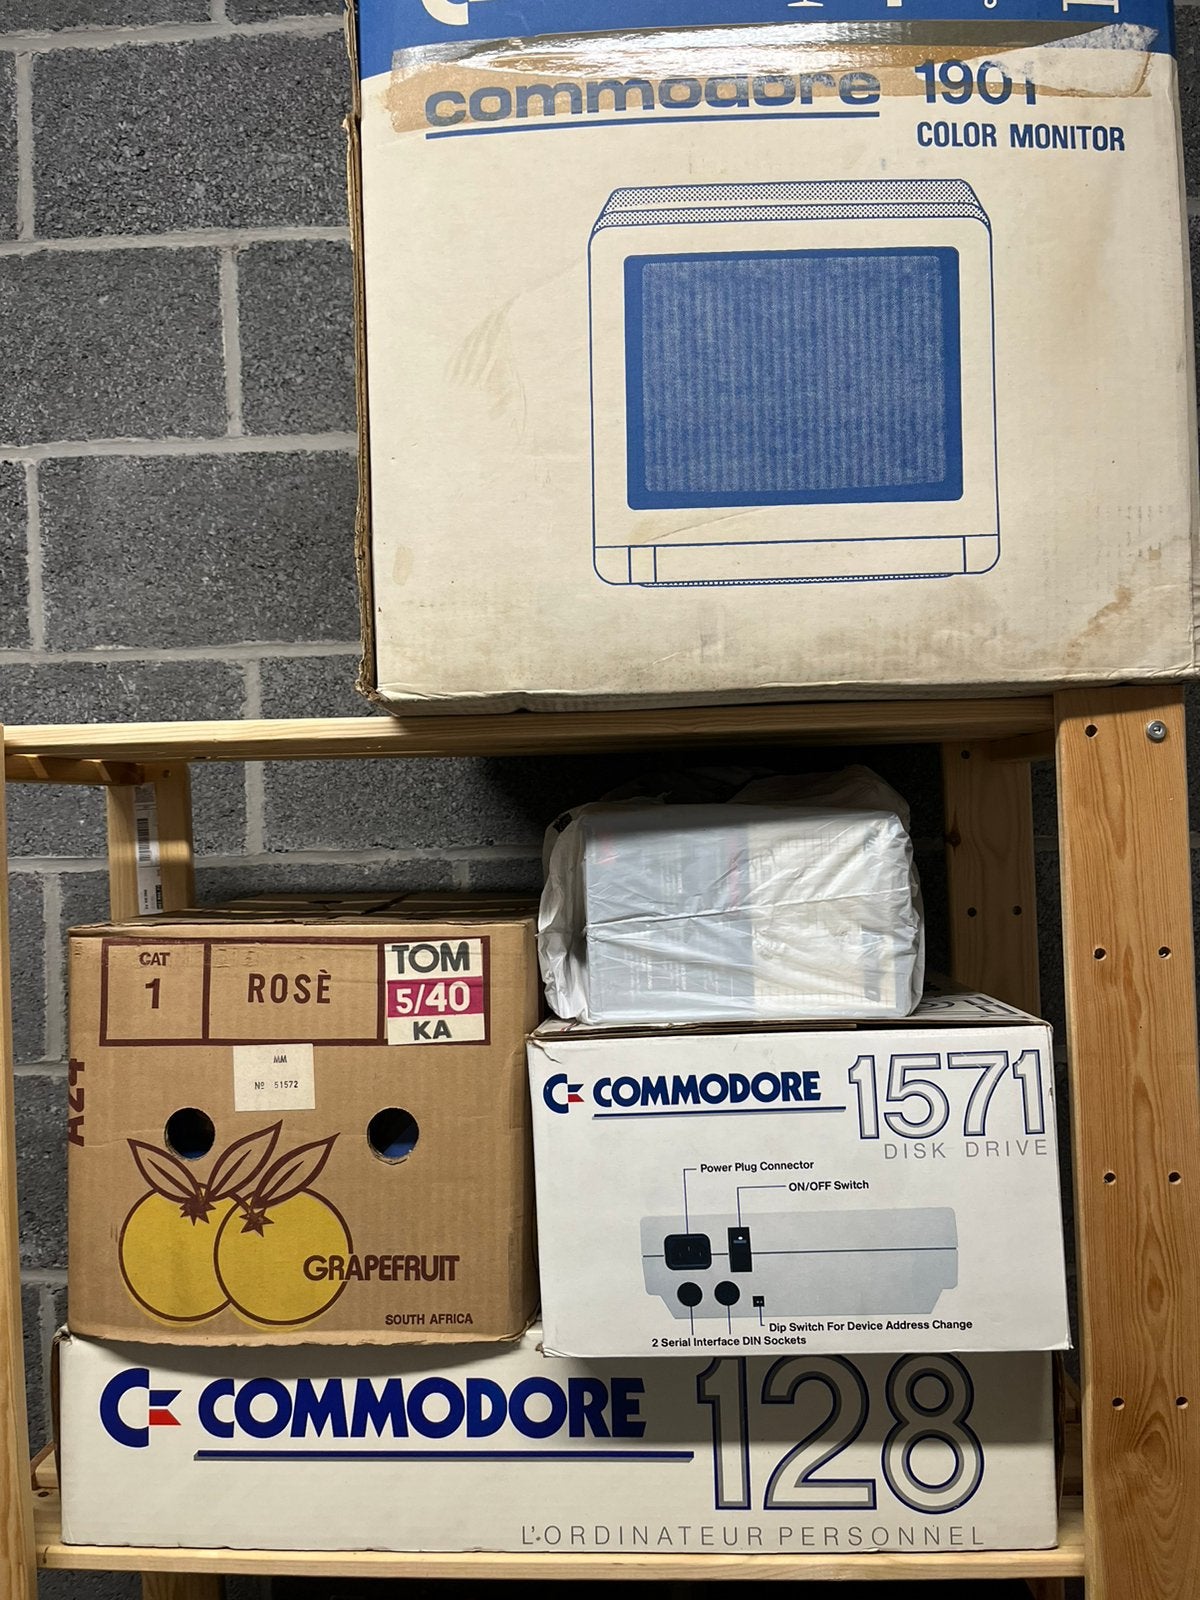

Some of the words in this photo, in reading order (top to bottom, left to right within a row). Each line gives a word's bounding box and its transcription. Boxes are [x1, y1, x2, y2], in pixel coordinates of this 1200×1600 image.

[425, 72, 881, 127] commodore
[917, 121, 997, 147] COLOR
[1010, 124, 1125, 151] MONITOR
[139, 951, 171, 966] CAT
[391, 941, 470, 974] TOM
[145, 977, 161, 1009] 1
[396, 981, 470, 1014] 5/40
[413, 1019, 452, 1041] KA
[274, 1080, 299, 1089] 51572
[593, 1071, 822, 1108] COMMODORE
[848, 1049, 1046, 1140] 1571
[884, 1142, 946, 1160] DISK
[965, 1138, 1049, 1158] DRIVE
[700, 1163, 732, 1173] Power
[735, 1162, 757, 1173] Plug
[759, 1160, 815, 1171] Connector
[788, 1181, 832, 1192] ON/OFF
[833, 1180, 870, 1191] Switch
[302, 1254, 461, 1282] GRAPEFRUIT
[384, 1314, 425, 1326] SOUTH
[429, 1313, 474, 1325] AFRICA
[769, 1322, 787, 1334] Dip
[789, 1321, 825, 1333] Switch
[827, 1321, 845, 1332] For
[847, 1320, 883, 1332] Device
[885, 1319, 930, 1330] Address
[932, 1319, 973, 1331] Change
[651, 1338, 659, 1348] 2
[661, 1337, 691, 1347] Serial
[693, 1336, 740, 1346] Interface
[742, 1336, 761, 1346] DIN
[763, 1335, 807, 1345] Sockets
[198, 1376, 647, 1439] COMMODORE
[696, 1353, 985, 1515] 128
[779, 1526, 985, 1546] PERSONNEL
